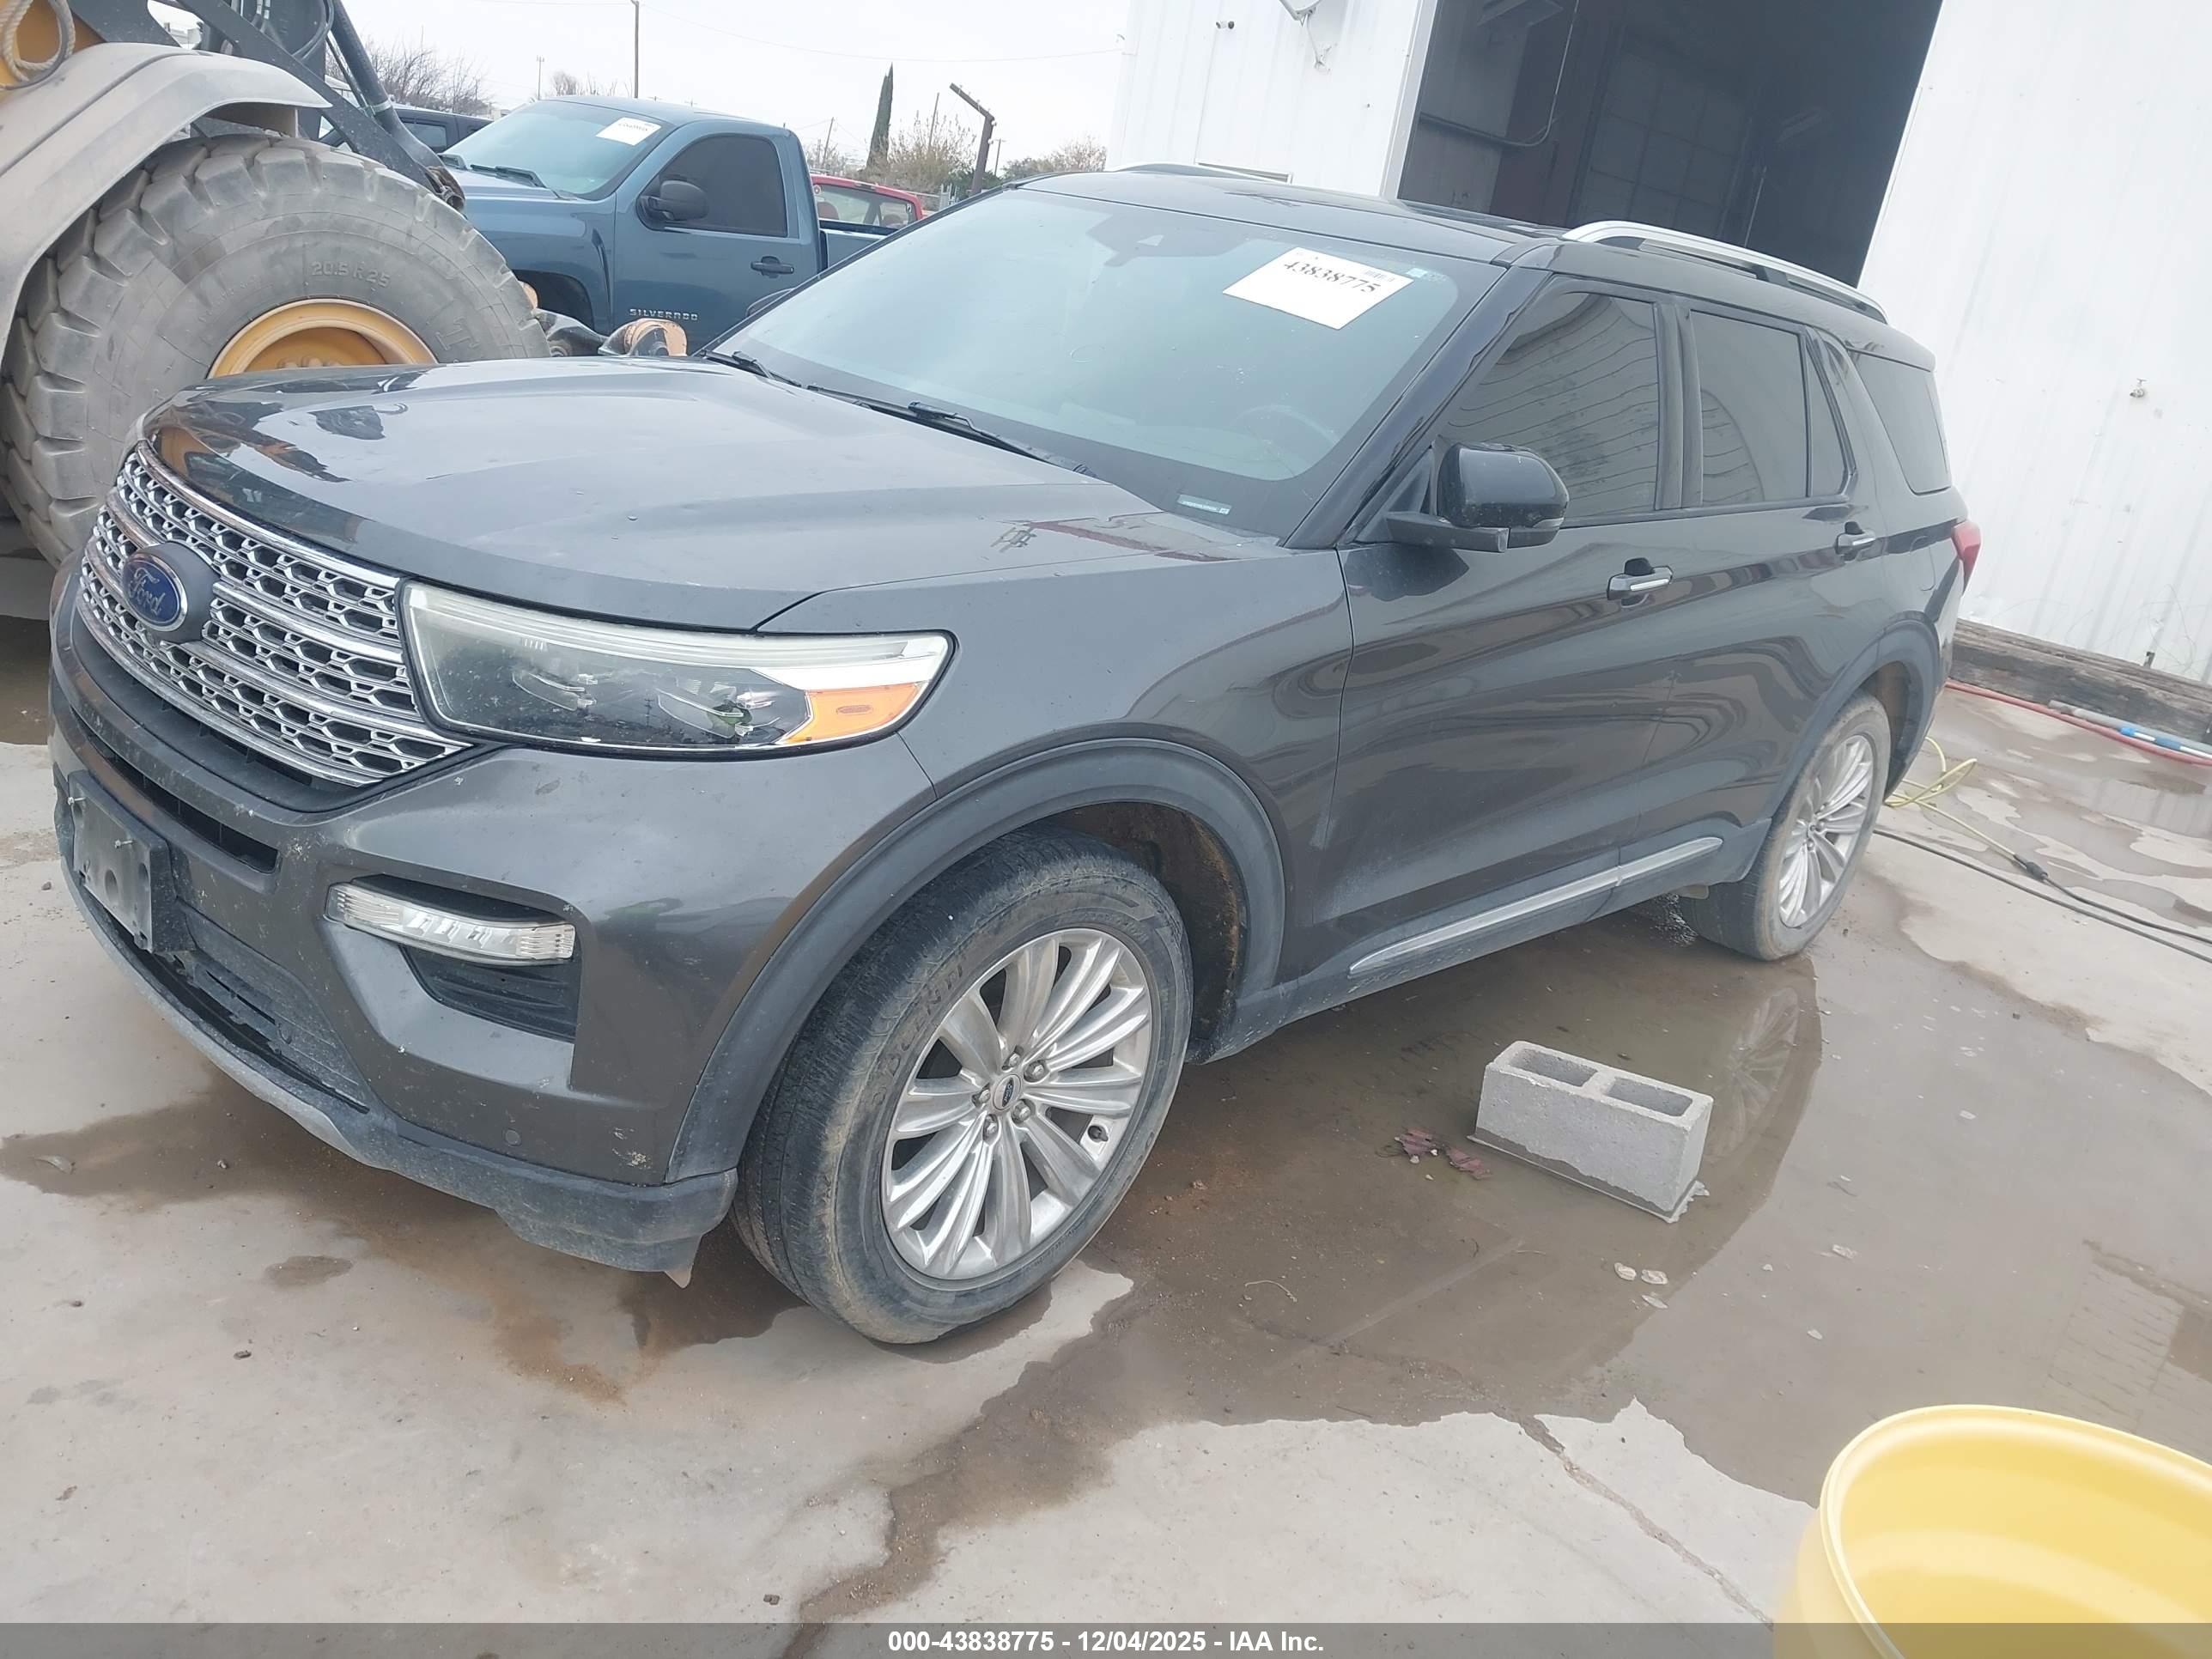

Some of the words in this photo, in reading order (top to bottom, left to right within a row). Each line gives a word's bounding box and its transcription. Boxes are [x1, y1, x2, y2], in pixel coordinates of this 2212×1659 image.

[311, 260, 349, 276] 20.5
[1284, 260, 1381, 293] 43838775
[629, 308, 698, 320] SILVERADO
[130, 568, 166, 616] Ford
